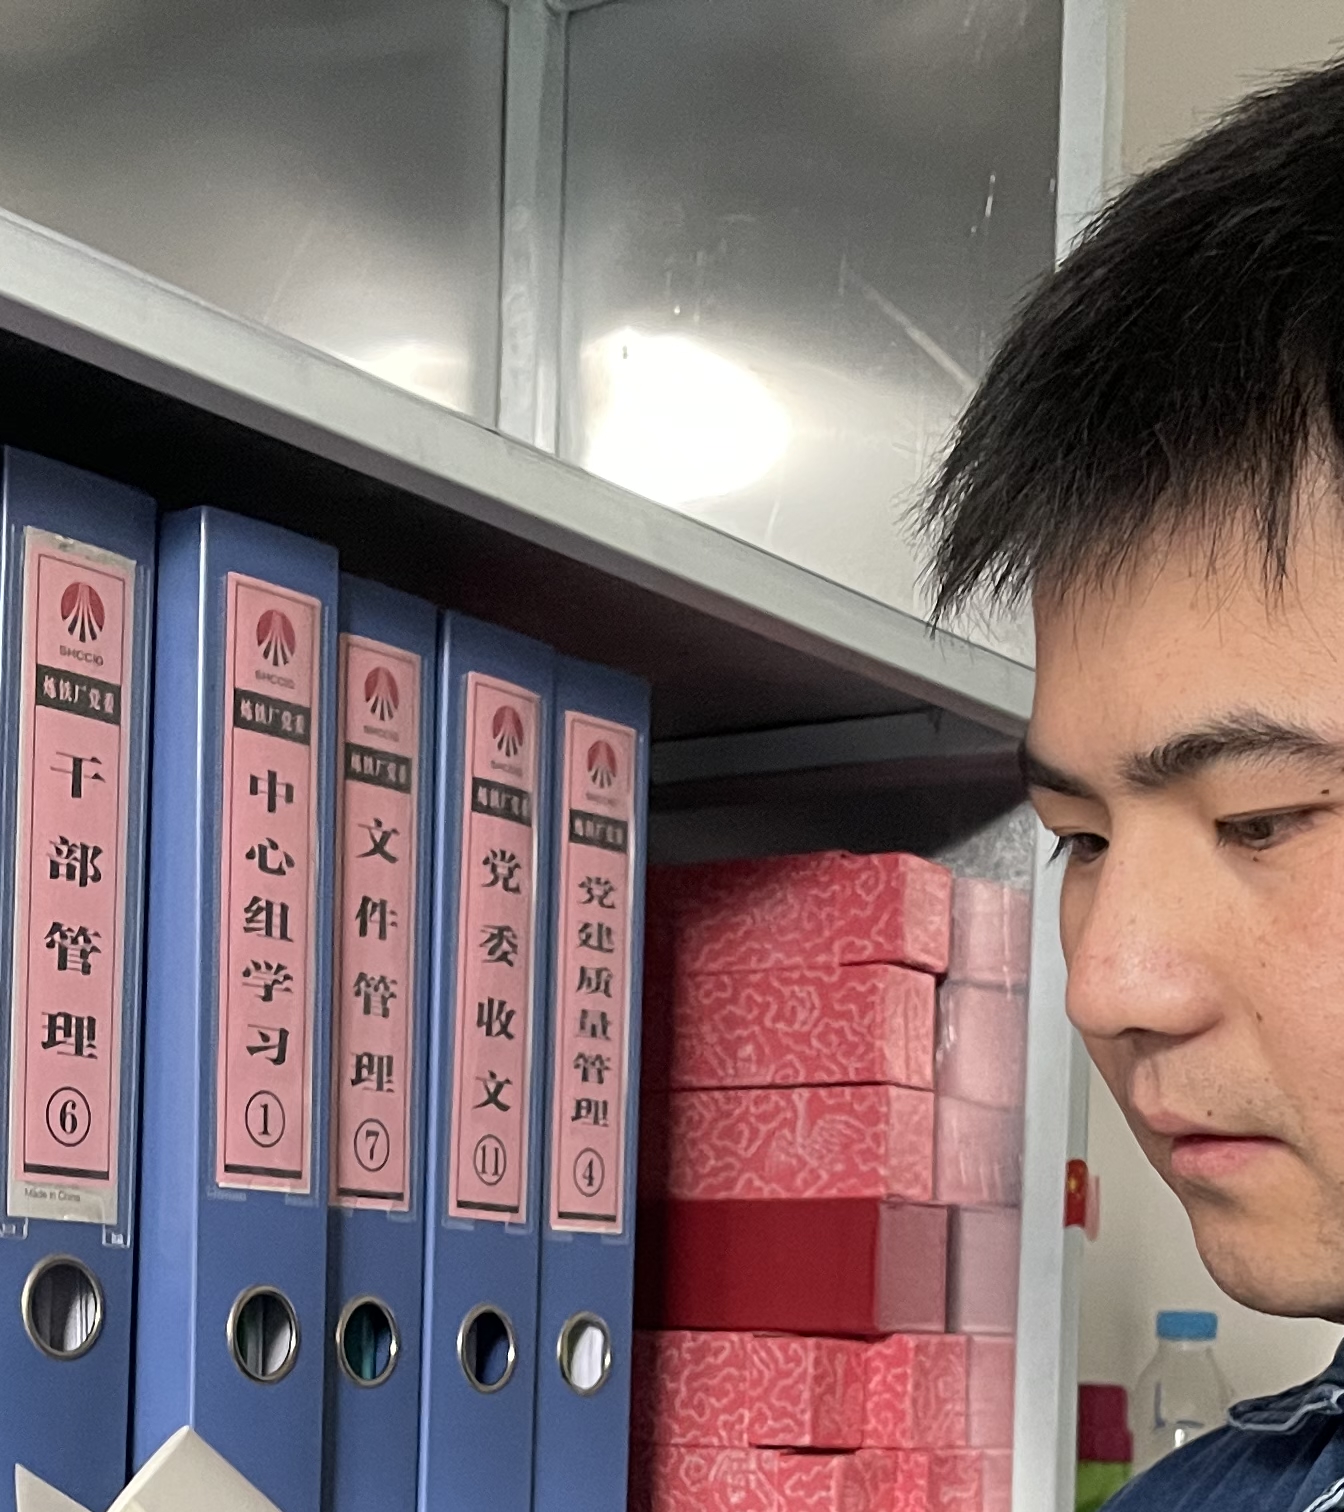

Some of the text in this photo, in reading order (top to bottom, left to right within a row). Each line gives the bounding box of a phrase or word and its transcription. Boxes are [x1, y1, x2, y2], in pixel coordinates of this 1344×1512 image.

[40, 750, 106, 1061] 干部管理
[241, 769, 295, 1066] 中心组学习
[350, 818, 400, 1093] 文件管理
[471, 849, 522, 1112] 党委收文
[570, 876, 617, 1128] 党建质量管理
[58, 1191, 80, 1201] China
